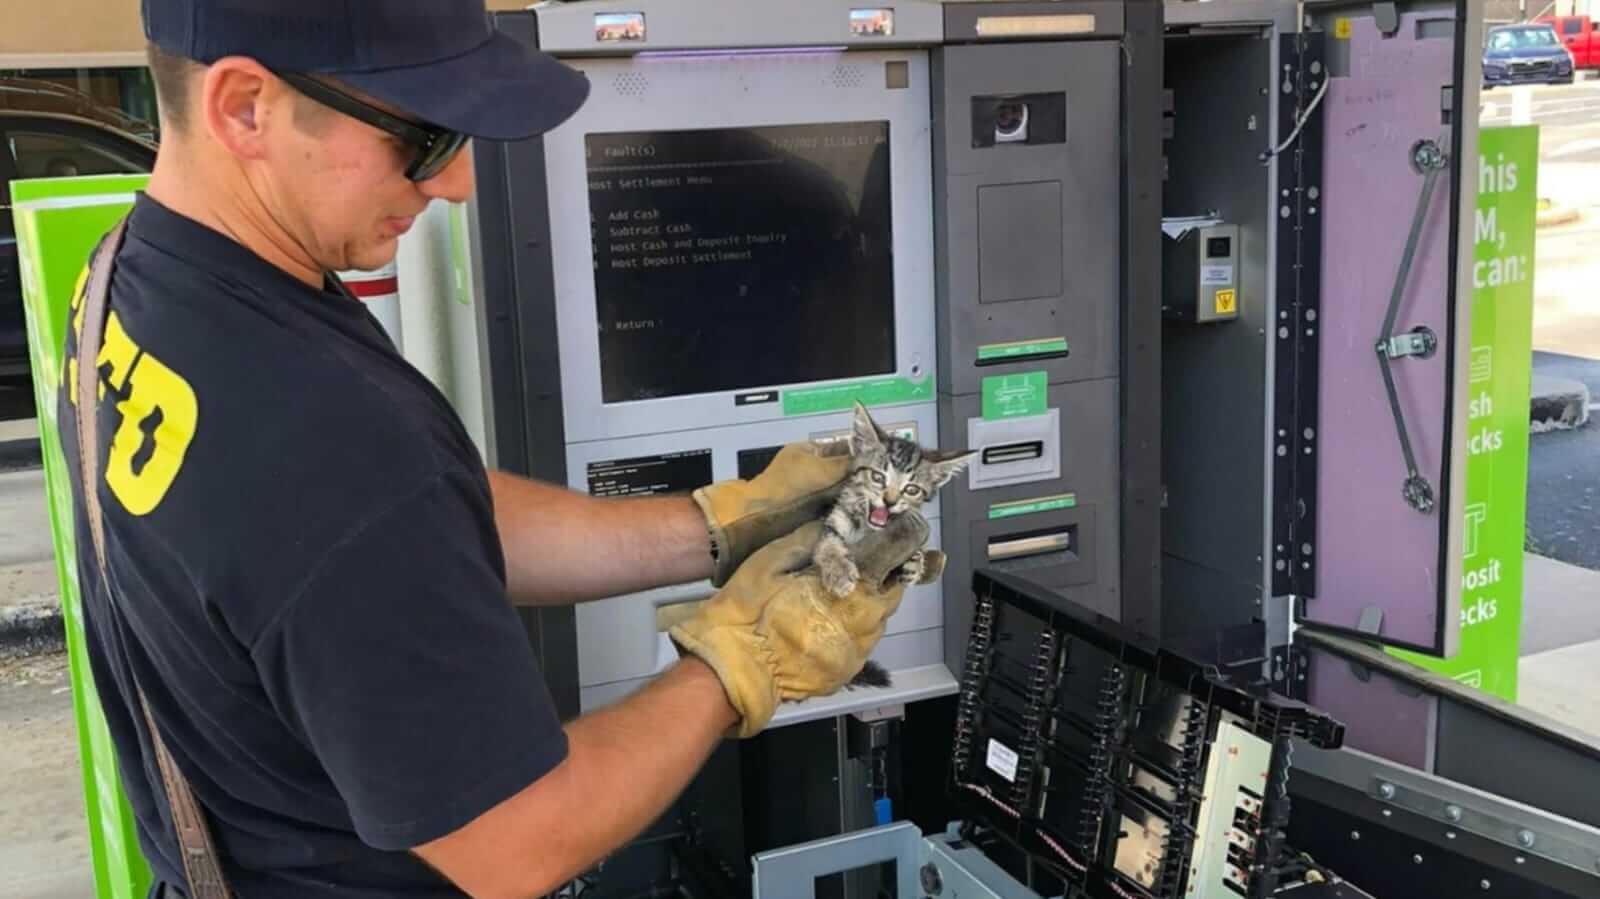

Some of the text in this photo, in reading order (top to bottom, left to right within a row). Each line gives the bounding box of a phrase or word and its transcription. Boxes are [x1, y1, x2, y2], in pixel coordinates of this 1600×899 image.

[605, 144, 655, 158] Fault(s)
[618, 176, 681, 189] Settlement
[608, 209, 659, 221] Add Cash
[609, 224, 692, 237] Subtract Cash
[610, 242, 637, 253] Host
[642, 240, 668, 250] Cash
[674, 239, 692, 249] and
[697, 235, 739, 248] Deposit
[611, 249, 753, 269] Host Deposit Settlement
[1472, 256, 1526, 289] can:
[615, 320, 654, 330] Return
